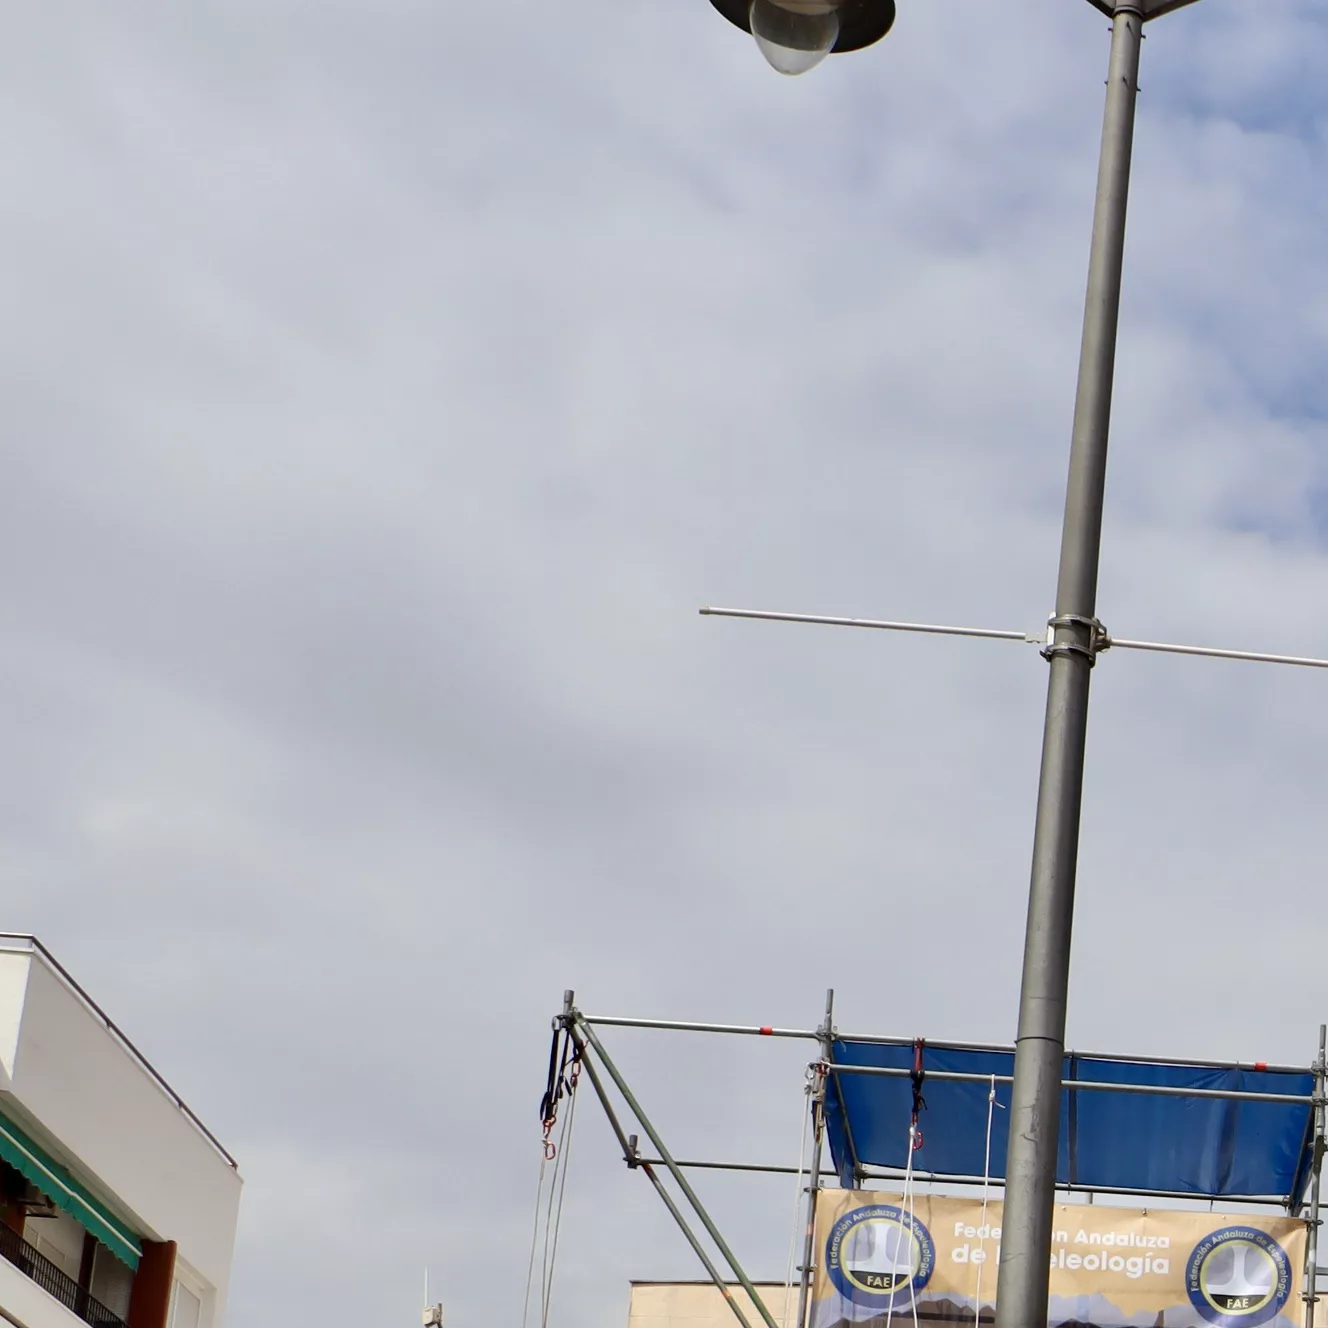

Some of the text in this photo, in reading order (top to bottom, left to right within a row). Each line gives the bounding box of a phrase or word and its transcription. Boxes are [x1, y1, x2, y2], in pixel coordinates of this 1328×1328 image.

[853, 1209, 897, 1222] Andaluza
[1074, 1229, 1170, 1249] Andaluza
[951, 1244, 987, 1265] de
[1190, 1243, 1212, 1291] Federación
[1212, 1230, 1254, 1245] Andaluza
[867, 1275, 891, 1288] FAE
[1227, 1298, 1249, 1309] FAE
